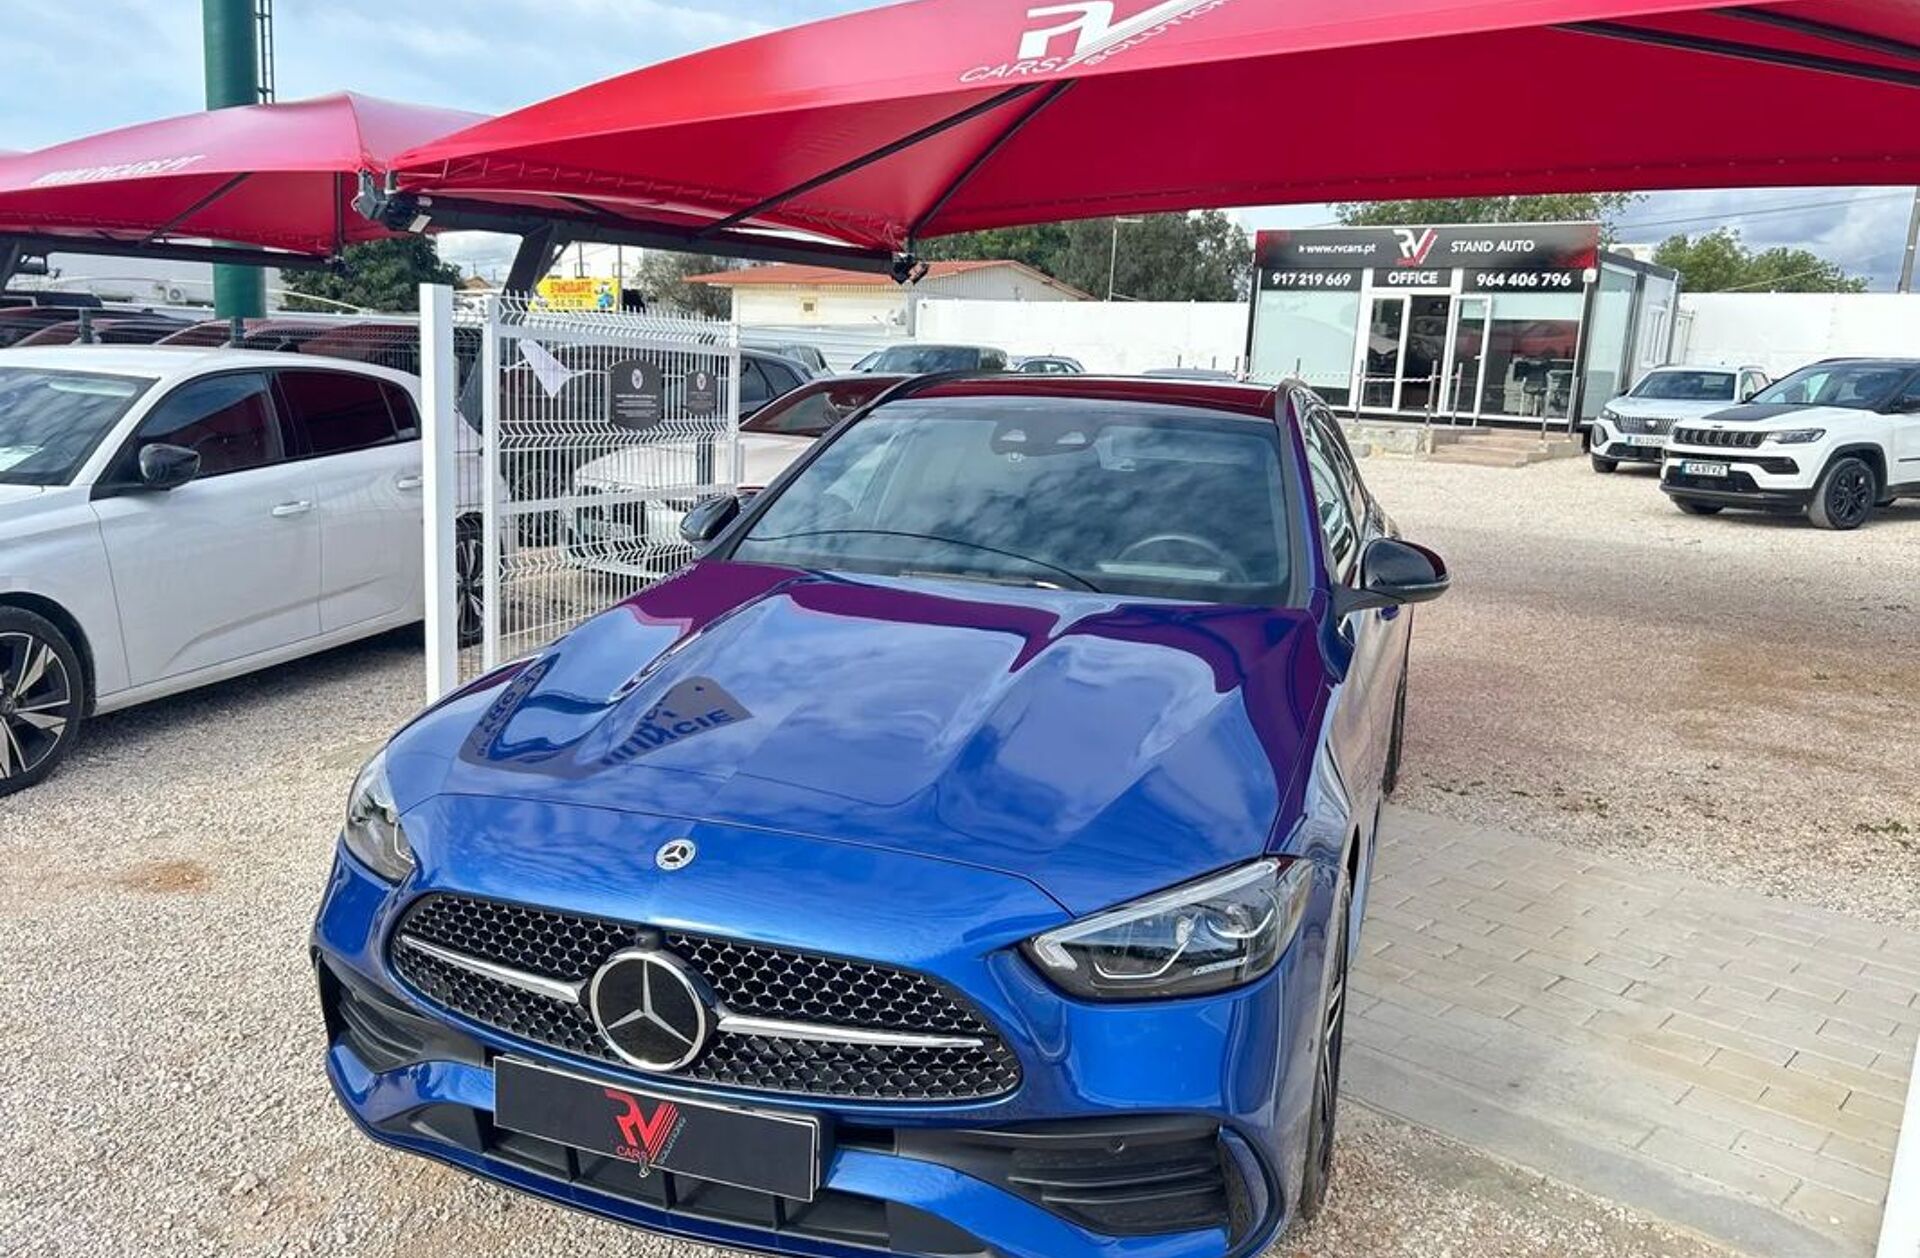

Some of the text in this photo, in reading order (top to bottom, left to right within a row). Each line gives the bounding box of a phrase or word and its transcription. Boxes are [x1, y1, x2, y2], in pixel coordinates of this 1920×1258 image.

[960, 57, 1062, 82] CARS
[1307, 243, 1376, 256] www.rvcars.pt
[1451, 239, 1535, 253] STAND AUTO
[1272, 272, 1351, 286] 917 219 669
[1387, 271, 1439, 285] OFFICE
[1476, 272, 1571, 286] 964 406 796
[604, 1088, 678, 1163] RV
[616, 1145, 648, 1162] CARS
